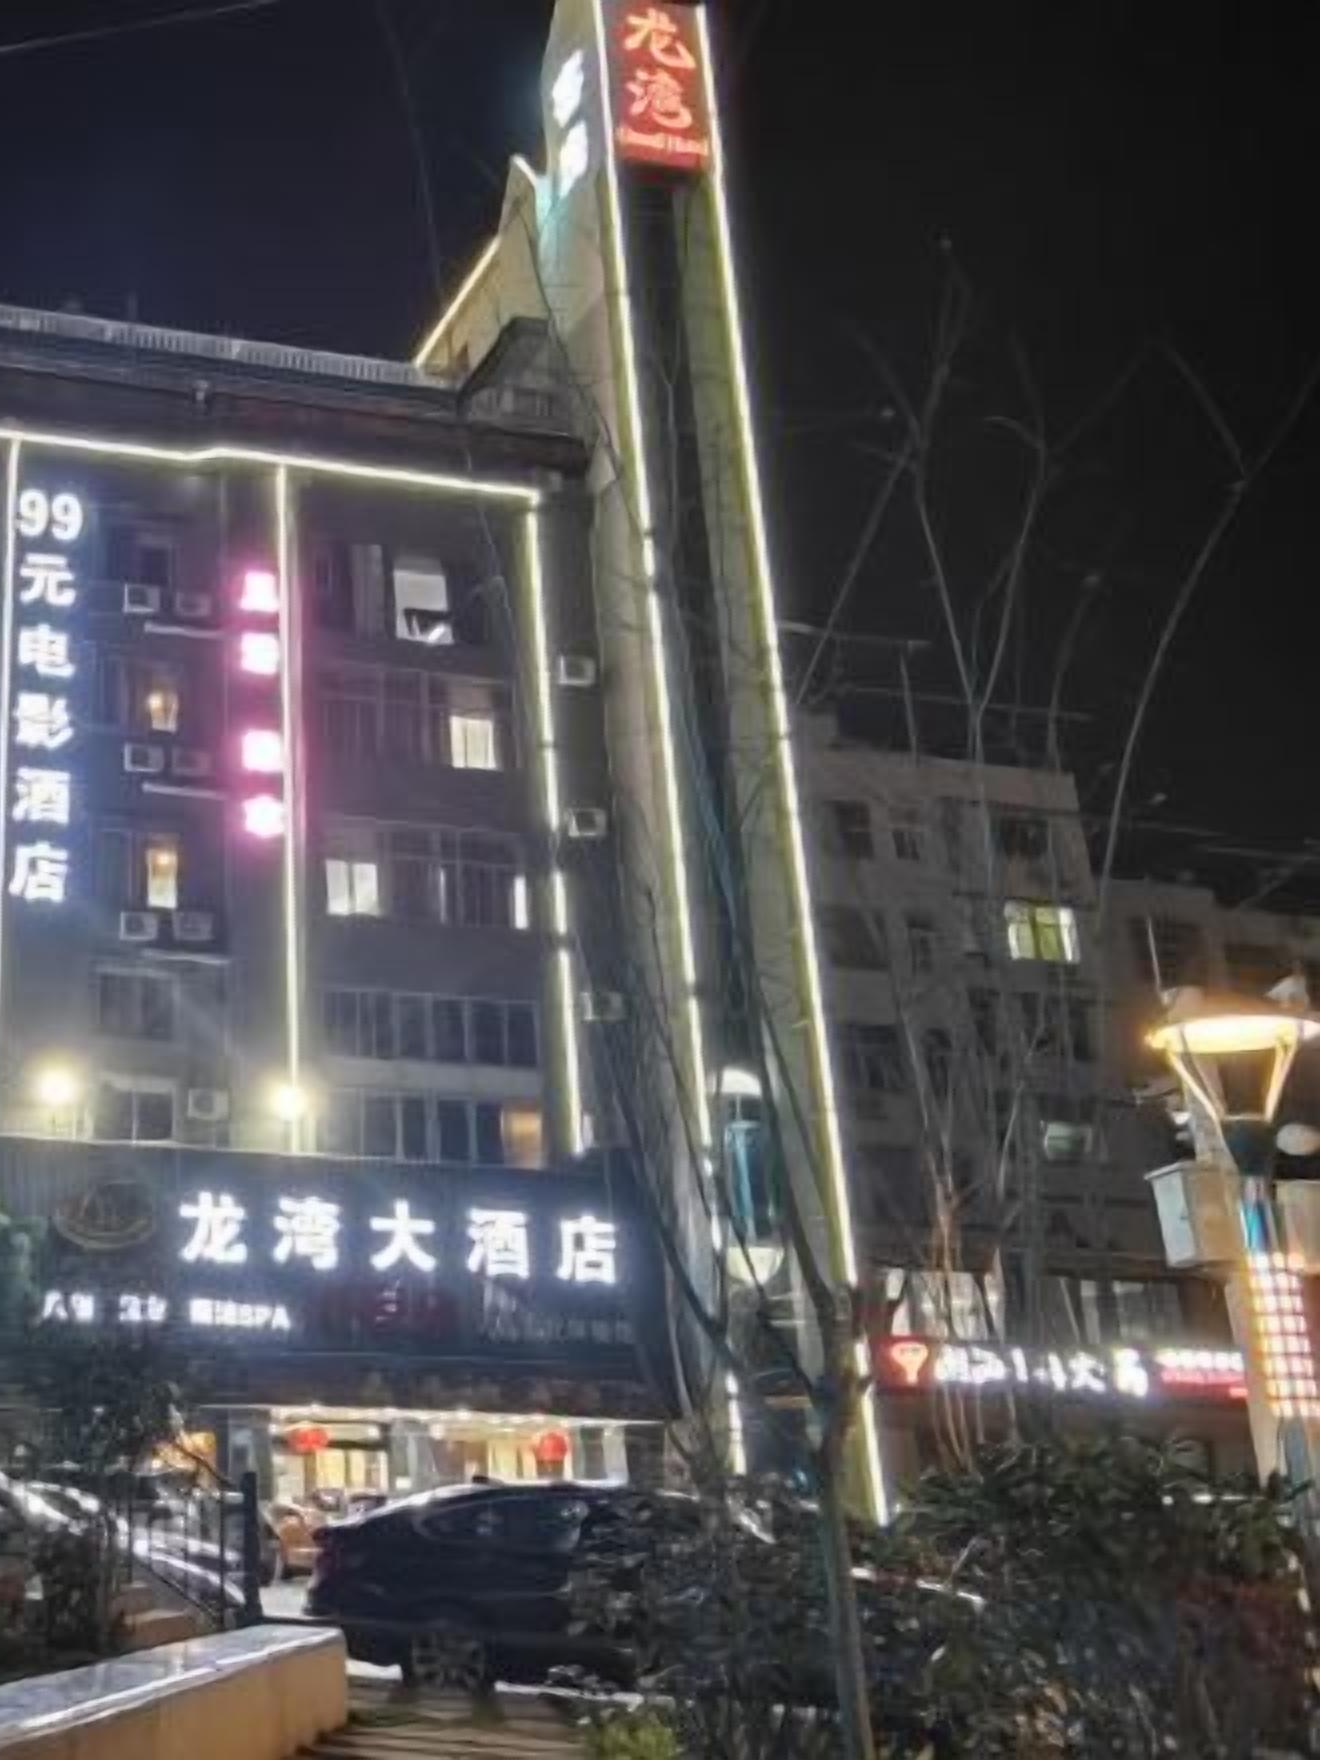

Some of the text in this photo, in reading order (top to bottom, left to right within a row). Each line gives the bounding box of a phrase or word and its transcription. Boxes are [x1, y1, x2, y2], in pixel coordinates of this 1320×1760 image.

[10, 490, 84, 903] 99元电影酒店
[178, 1190, 619, 1284] 龙湾大酒店
